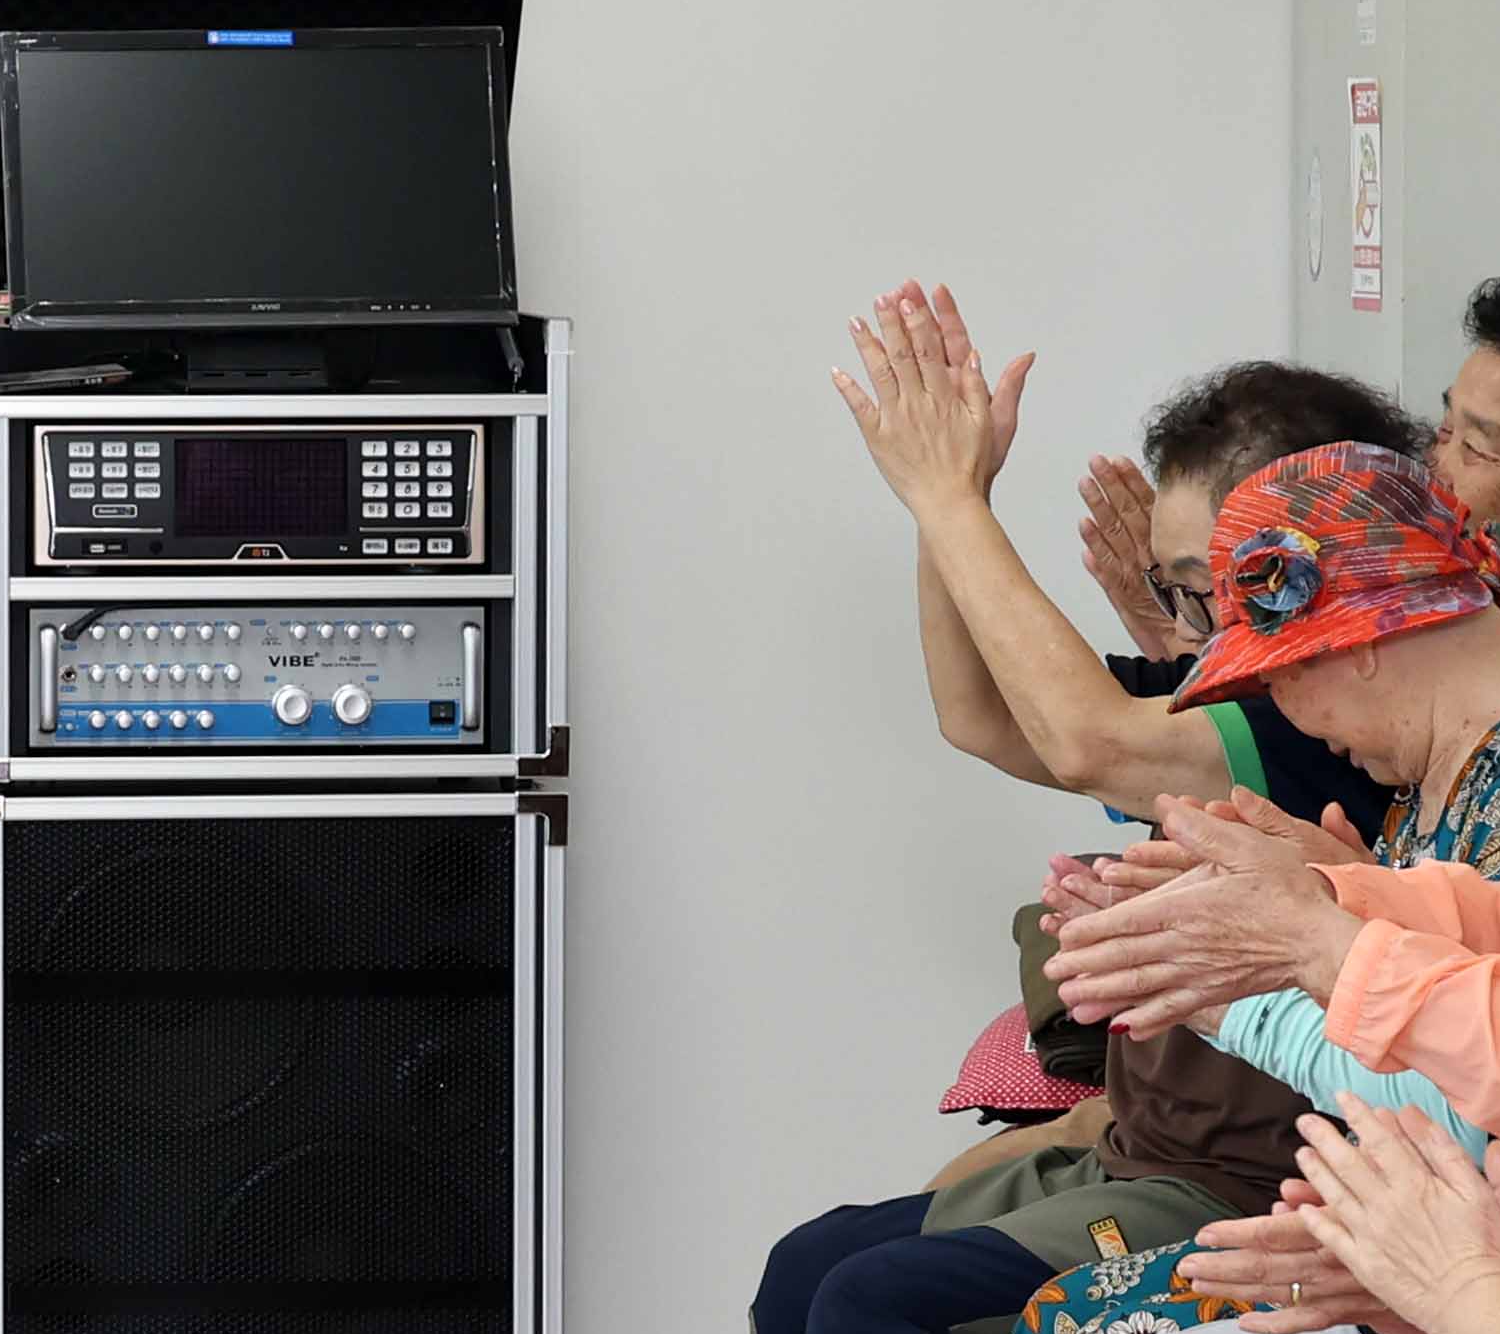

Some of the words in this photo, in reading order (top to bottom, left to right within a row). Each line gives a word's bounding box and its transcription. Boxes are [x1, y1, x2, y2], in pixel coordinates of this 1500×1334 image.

[372, 443, 377, 452] 1
[403, 444, 411, 453] 2
[435, 444, 443, 453] 3
[371, 464, 379, 474] 4
[404, 464, 411, 474] 5
[435, 464, 443, 474] 6
[372, 484, 378, 494] 7
[404, 485, 411, 494] 8
[436, 484, 444, 494] 9
[268, 654, 316, 668] VIBE
